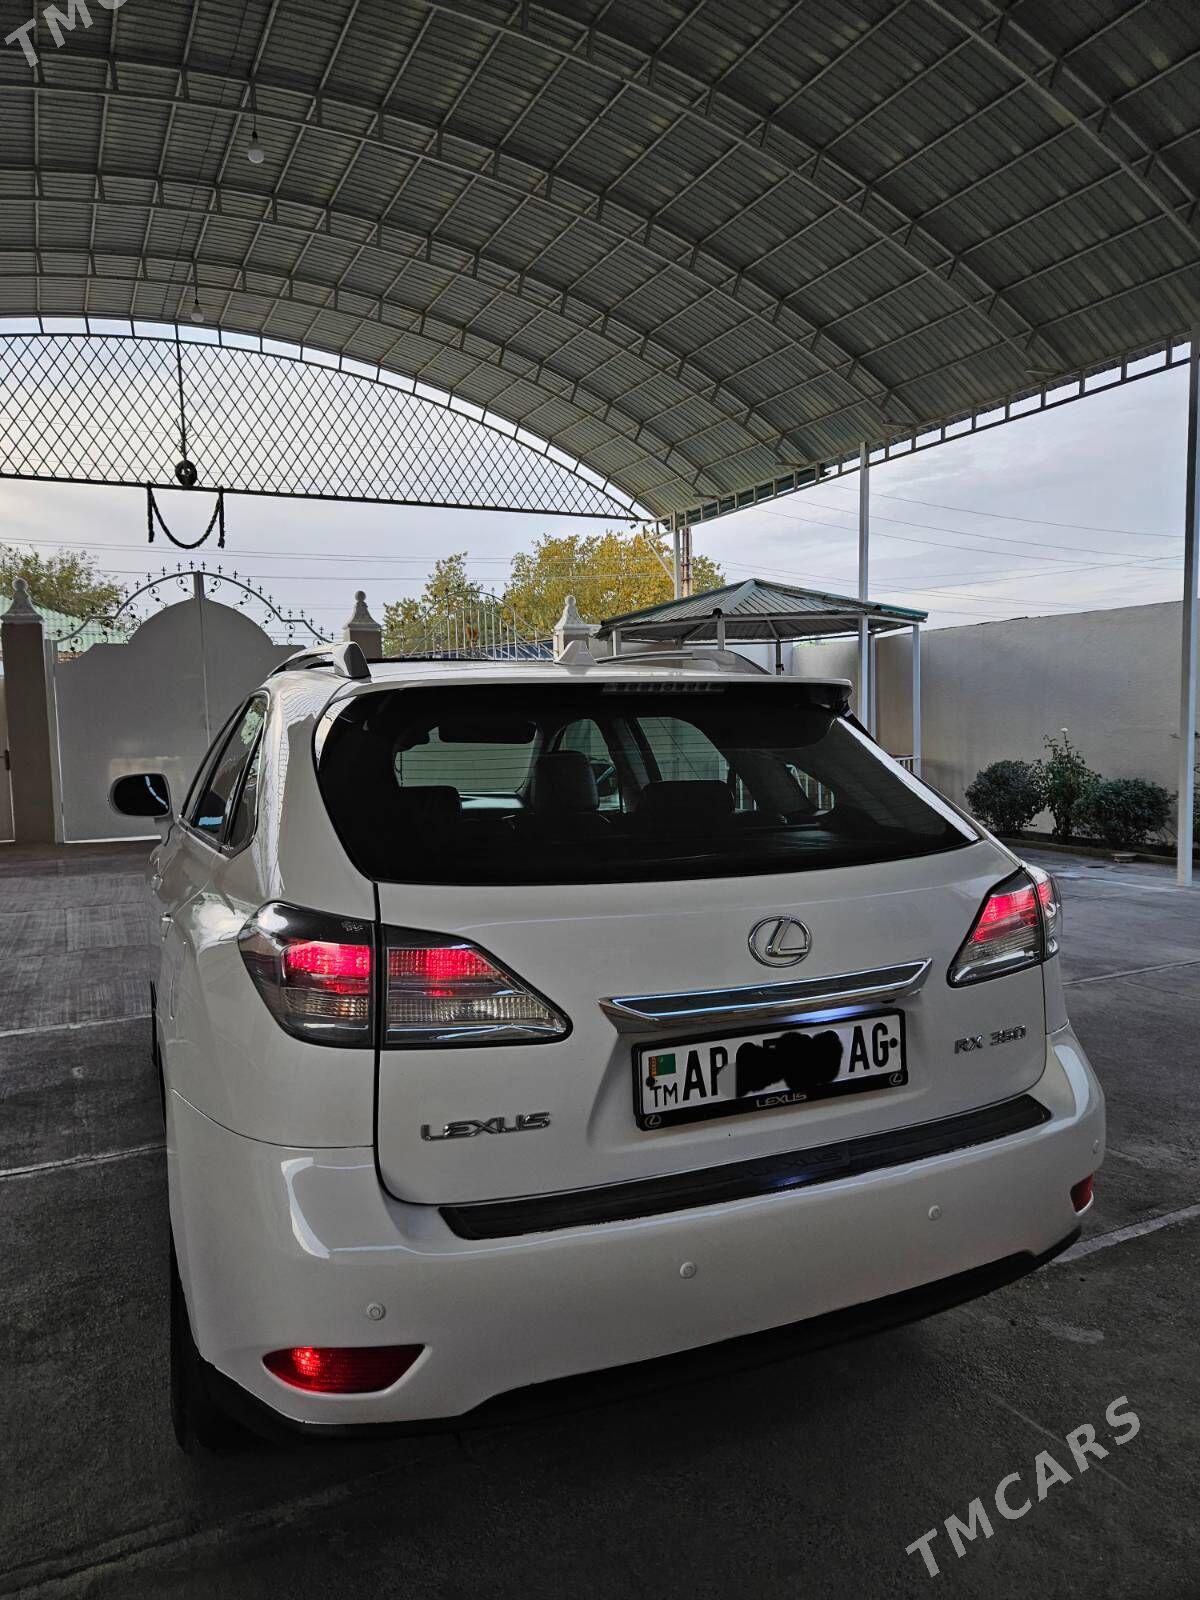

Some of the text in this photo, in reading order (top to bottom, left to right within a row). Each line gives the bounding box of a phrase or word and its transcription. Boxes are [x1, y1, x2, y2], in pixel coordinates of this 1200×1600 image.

[954, 1025, 1027, 1054] RX 350
[682, 1046, 729, 1101] AP
[848, 1022, 889, 1073] AG
[650, 1082, 678, 1107] TM
[756, 1093, 808, 1108] LEXUS
[420, 1111, 551, 1141] LEXUS
